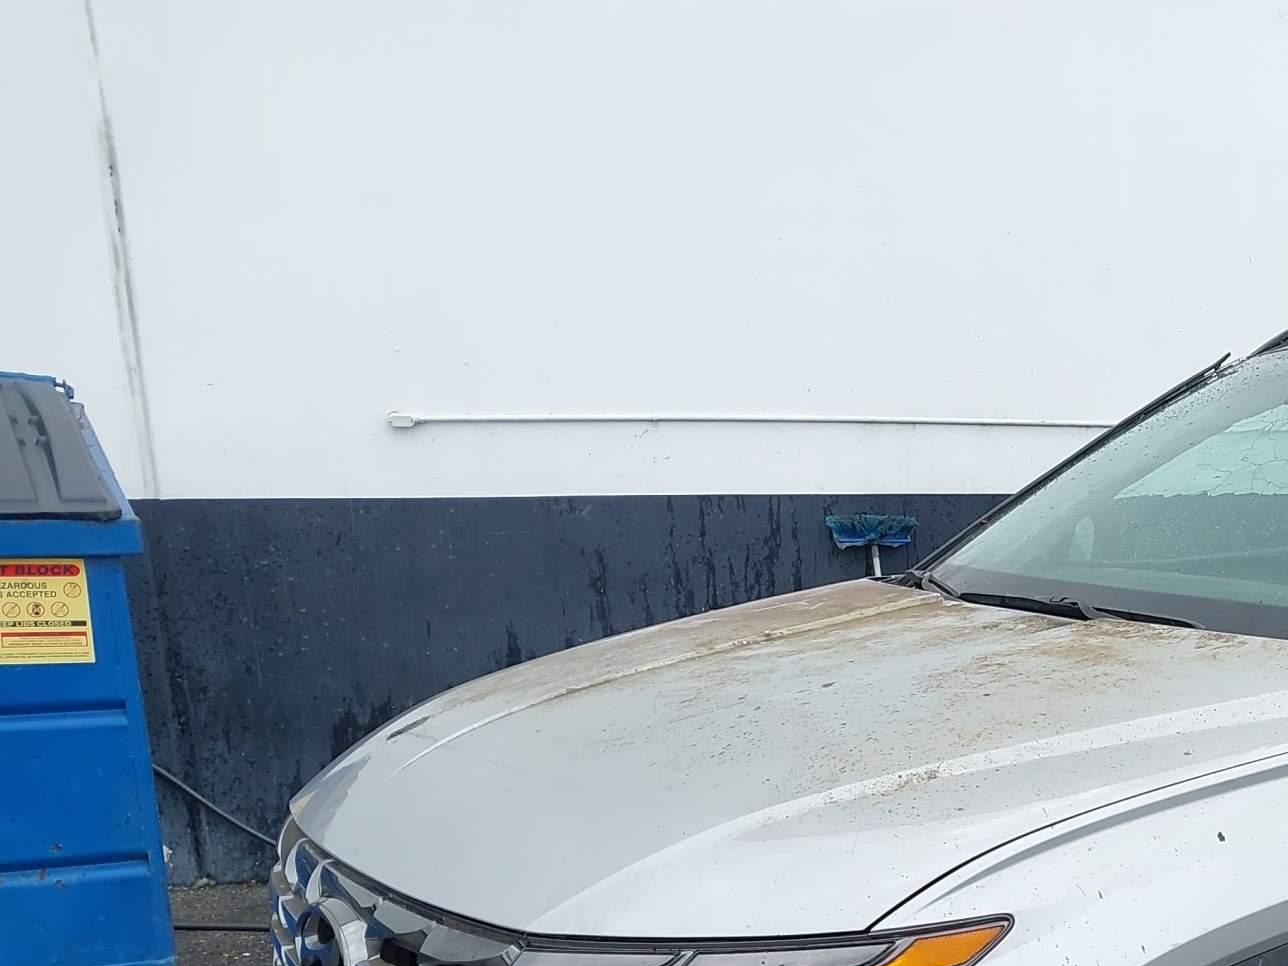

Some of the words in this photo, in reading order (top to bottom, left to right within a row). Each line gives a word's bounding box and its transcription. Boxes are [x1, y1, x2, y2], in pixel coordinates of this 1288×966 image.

[16, 565, 73, 576] BLOCK
[0, 582, 48, 590] ZARDOUS
[6, 590, 57, 598] ACCEPTED
